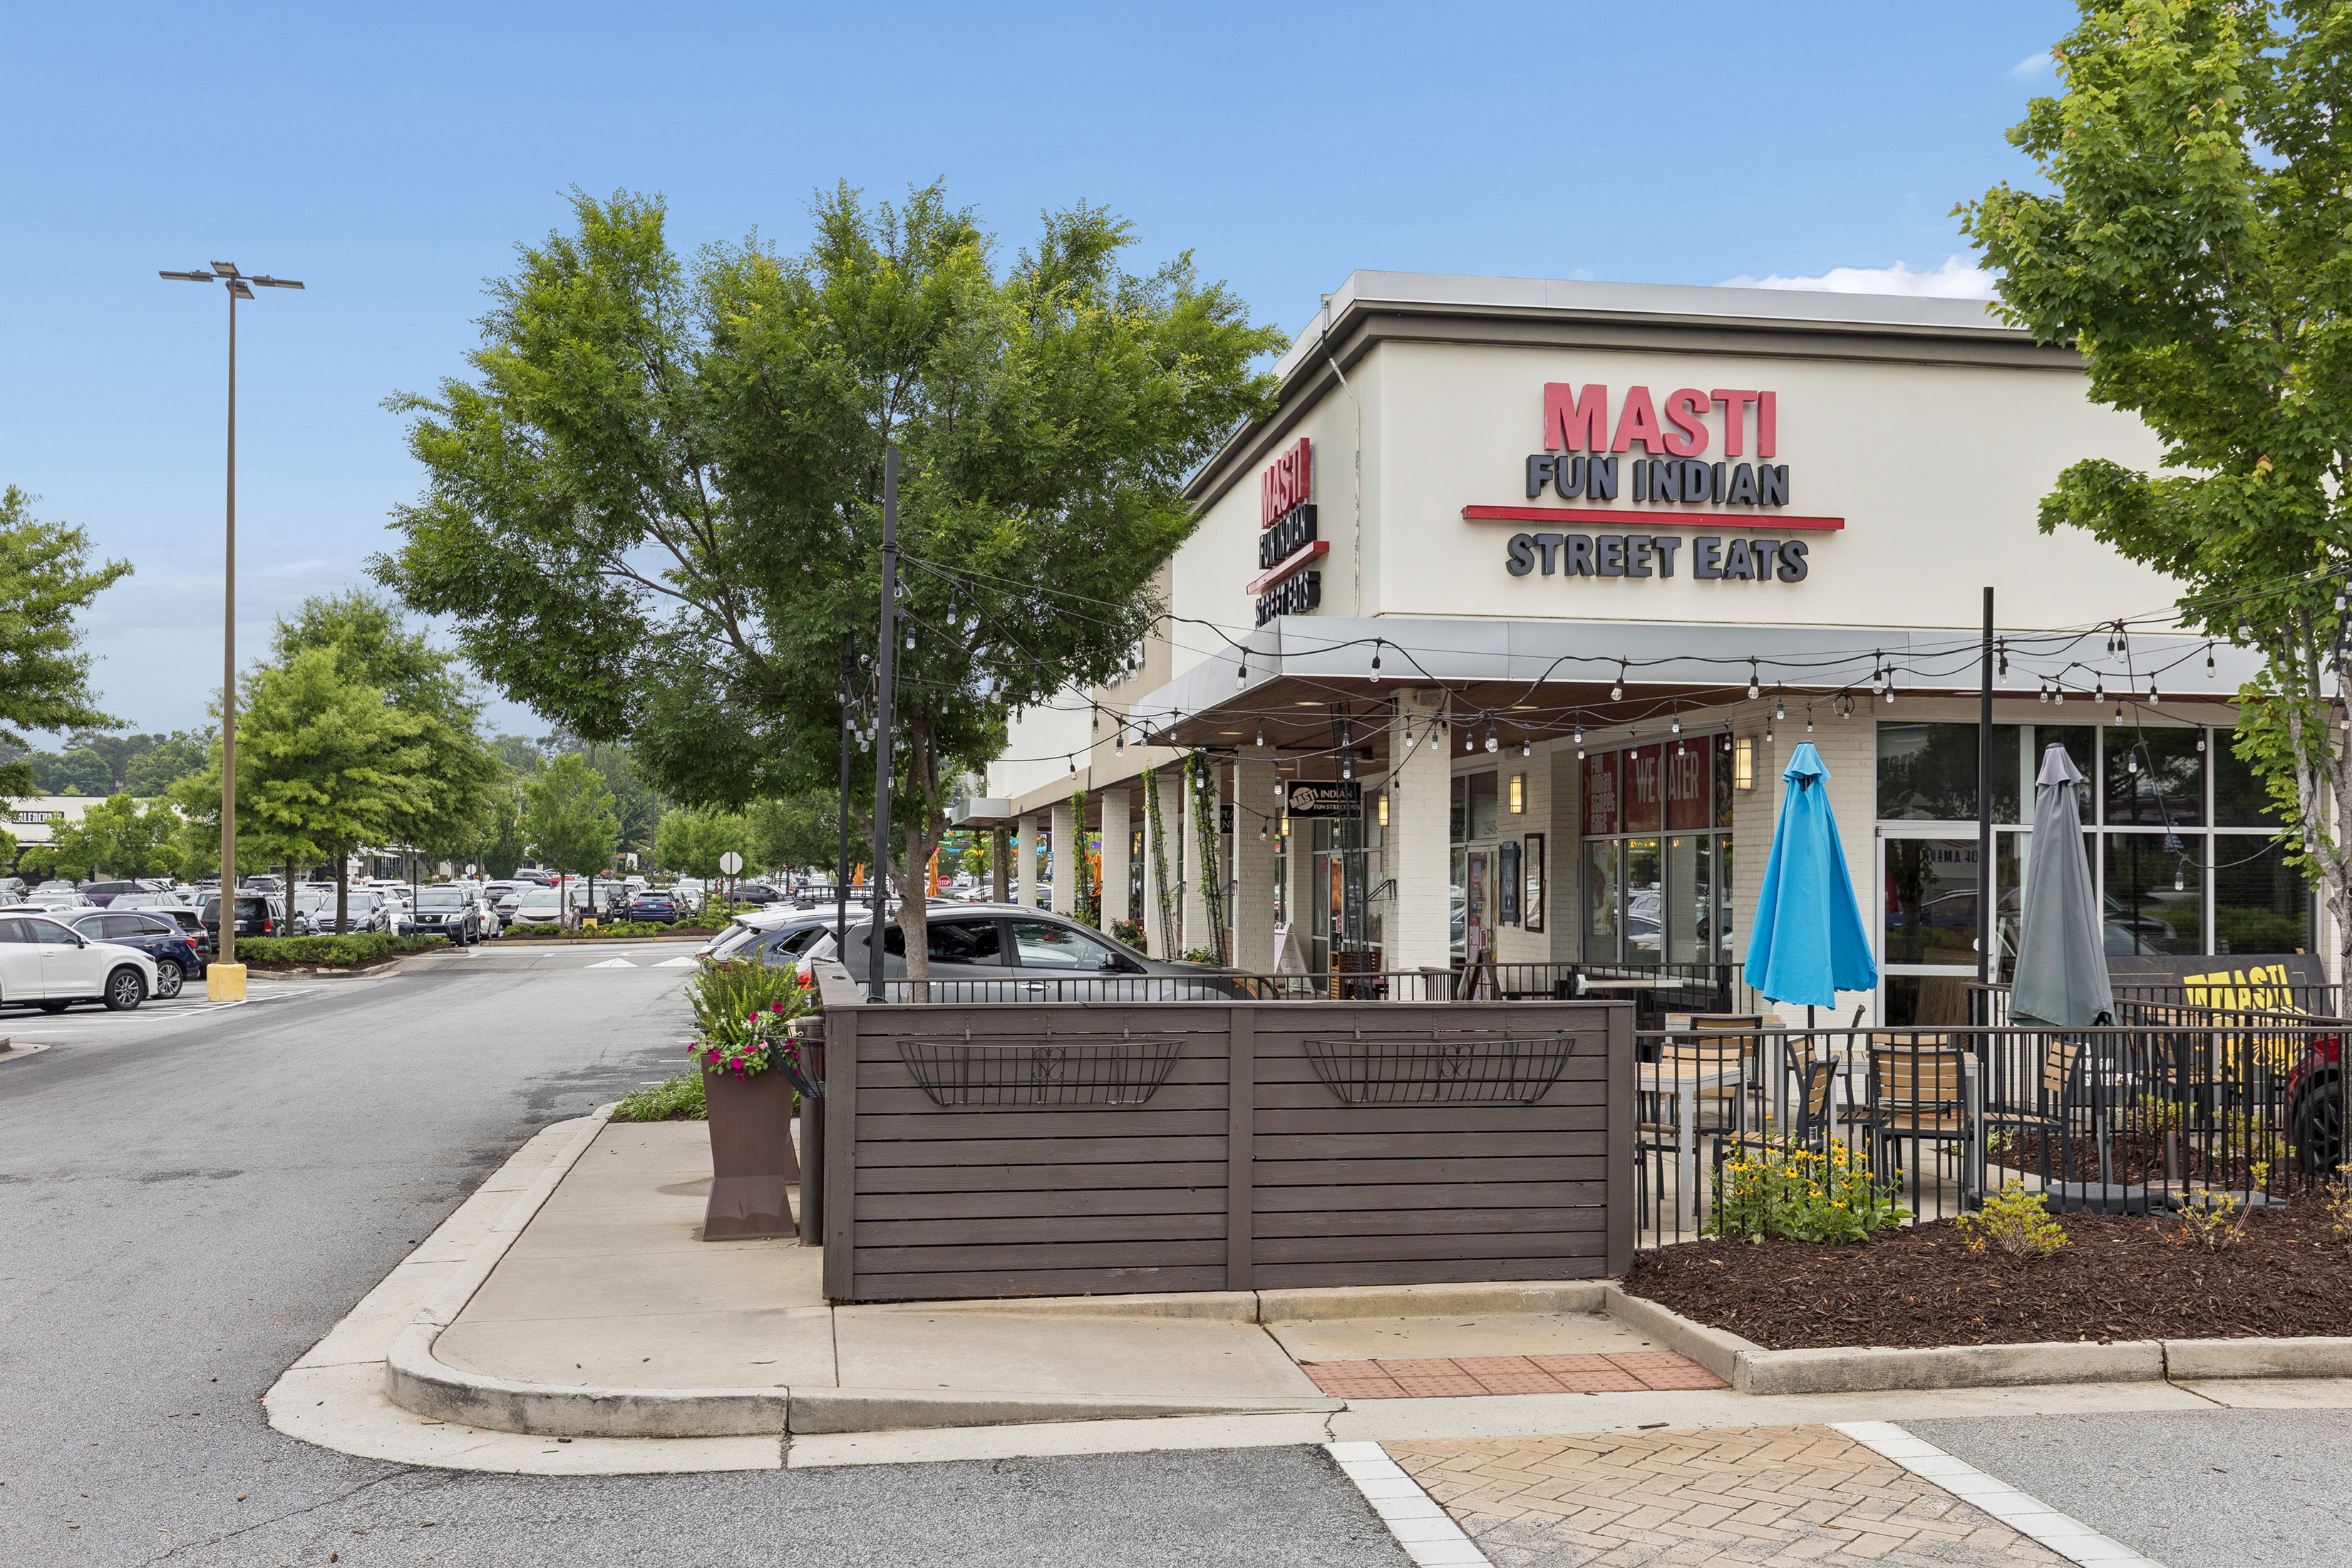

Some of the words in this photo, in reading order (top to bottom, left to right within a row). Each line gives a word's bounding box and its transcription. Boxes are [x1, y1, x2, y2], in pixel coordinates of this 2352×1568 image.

[1544, 382, 1776, 458] MASTI
[1261, 437, 1310, 529] MASTI
[1526, 454, 1619, 500] FUN
[1632, 460, 1789, 505] INDIAN
[1259, 526, 1276, 569] FUN
[1276, 504, 1317, 561] INDIAN
[1506, 533, 1681, 579] STREET
[1693, 536, 1808, 583] EATS
[1288, 570, 1321, 615] EATS
[1289, 788, 1319, 809] MASTI
[1636, 757, 1656, 803] WE
[2183, 964, 2293, 1017] MASTI
